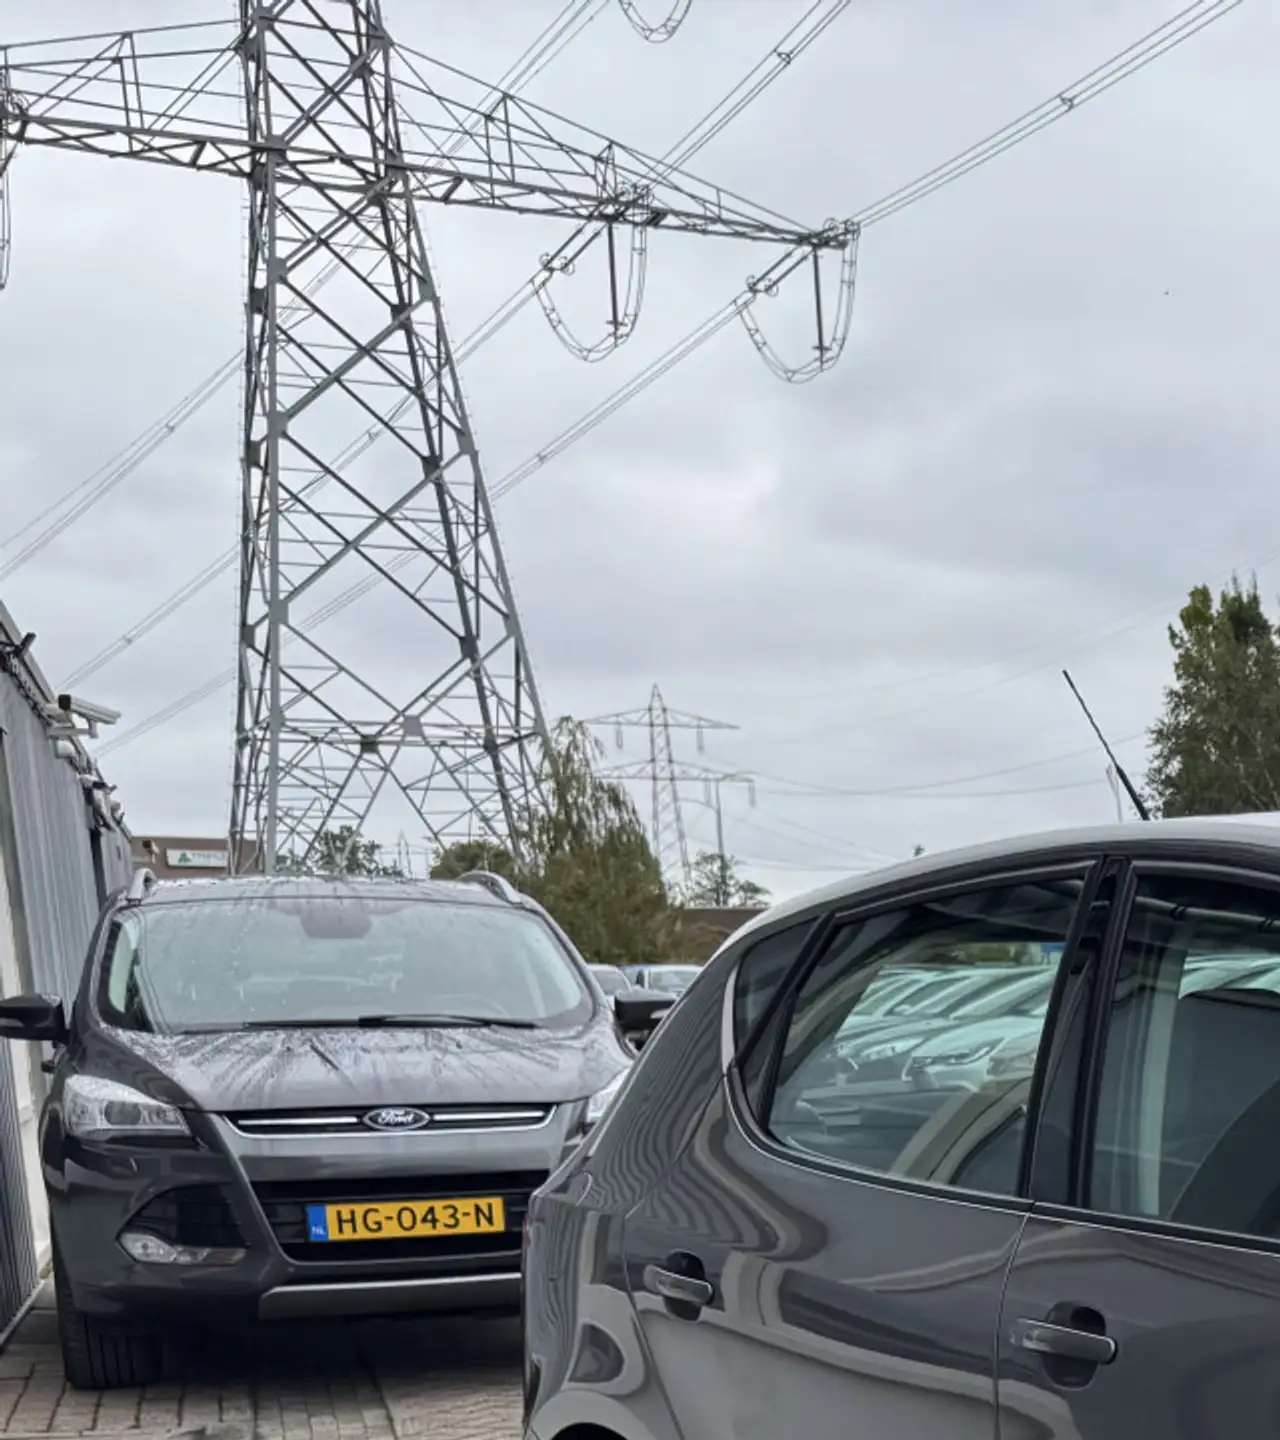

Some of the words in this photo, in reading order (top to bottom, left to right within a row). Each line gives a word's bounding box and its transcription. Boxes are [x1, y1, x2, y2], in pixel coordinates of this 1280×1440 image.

[377, 1109, 415, 1125] Ford
[336, 1202, 495, 1235] HG-043-N
[312, 1226, 327, 1236] NL
